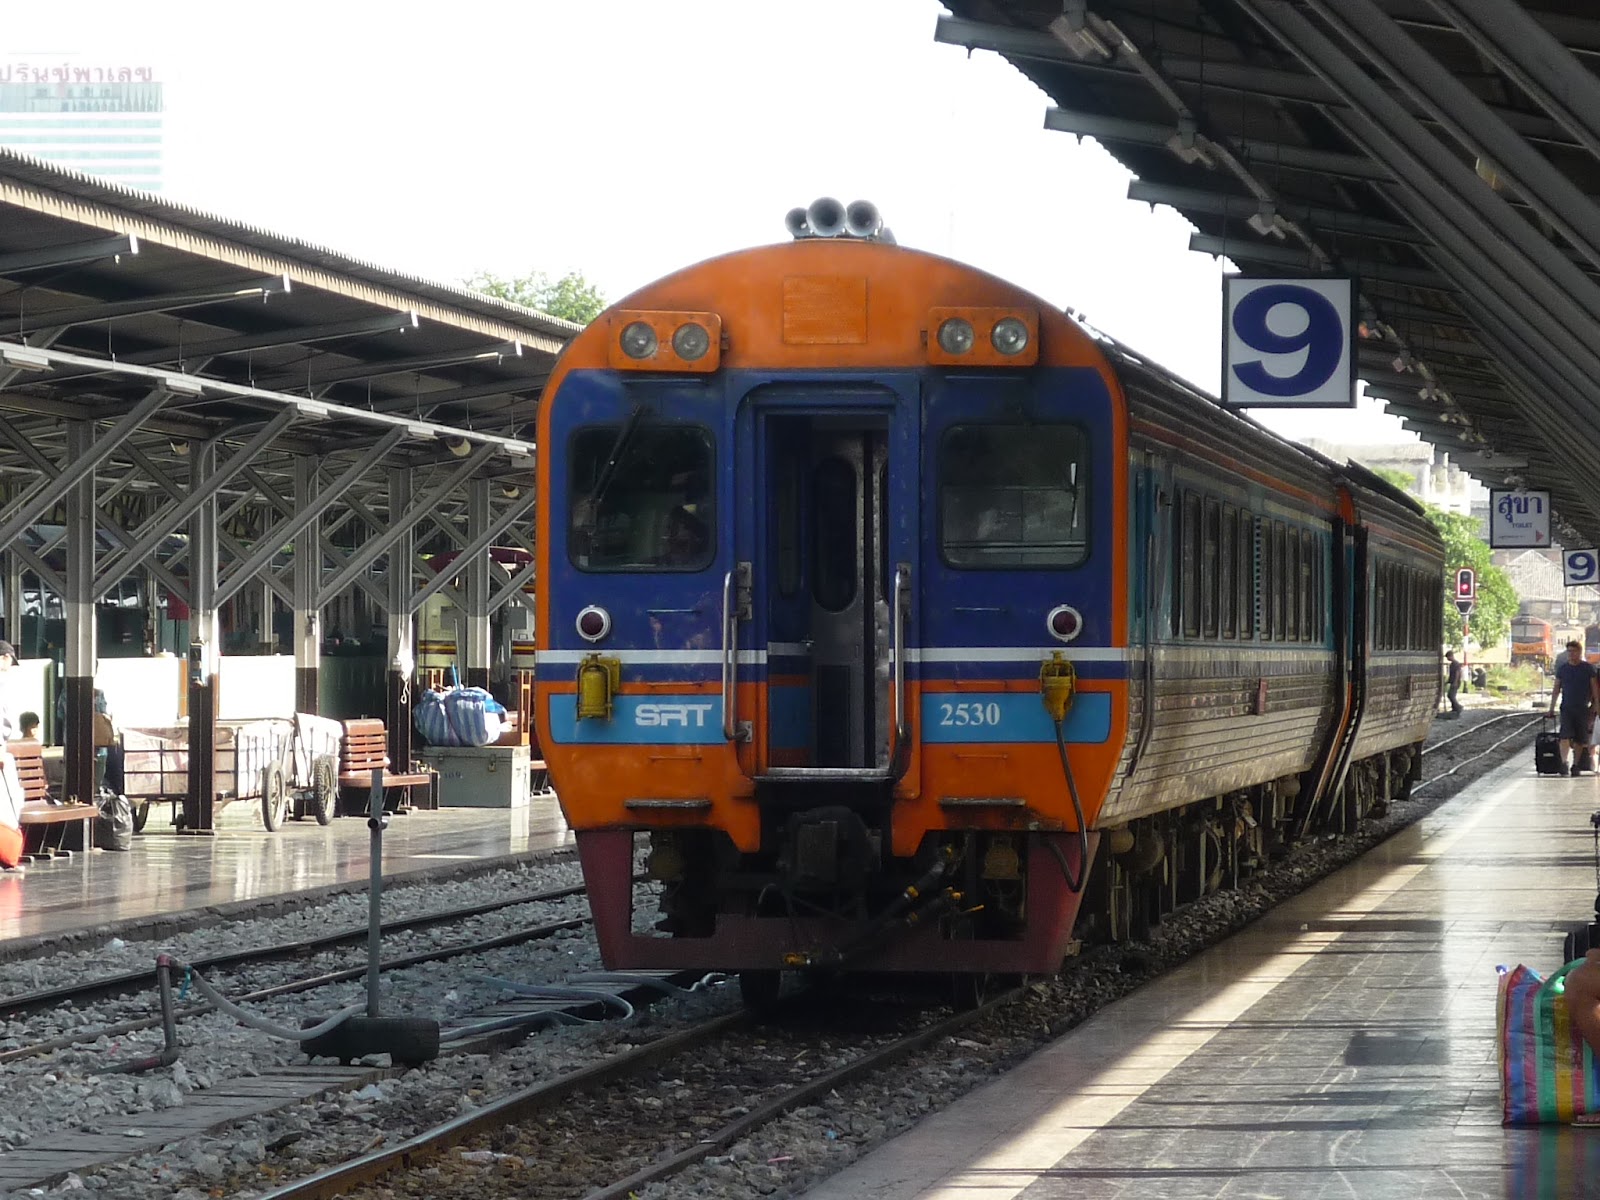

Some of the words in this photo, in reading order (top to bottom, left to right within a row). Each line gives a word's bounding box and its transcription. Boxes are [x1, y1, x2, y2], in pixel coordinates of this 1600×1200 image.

[1232, 284, 1344, 397] 9
[1498, 494, 1542, 523] สุขา
[1567, 551, 1597, 581] 9
[635, 703, 712, 728] SRT
[939, 702, 1001, 727] 2530
